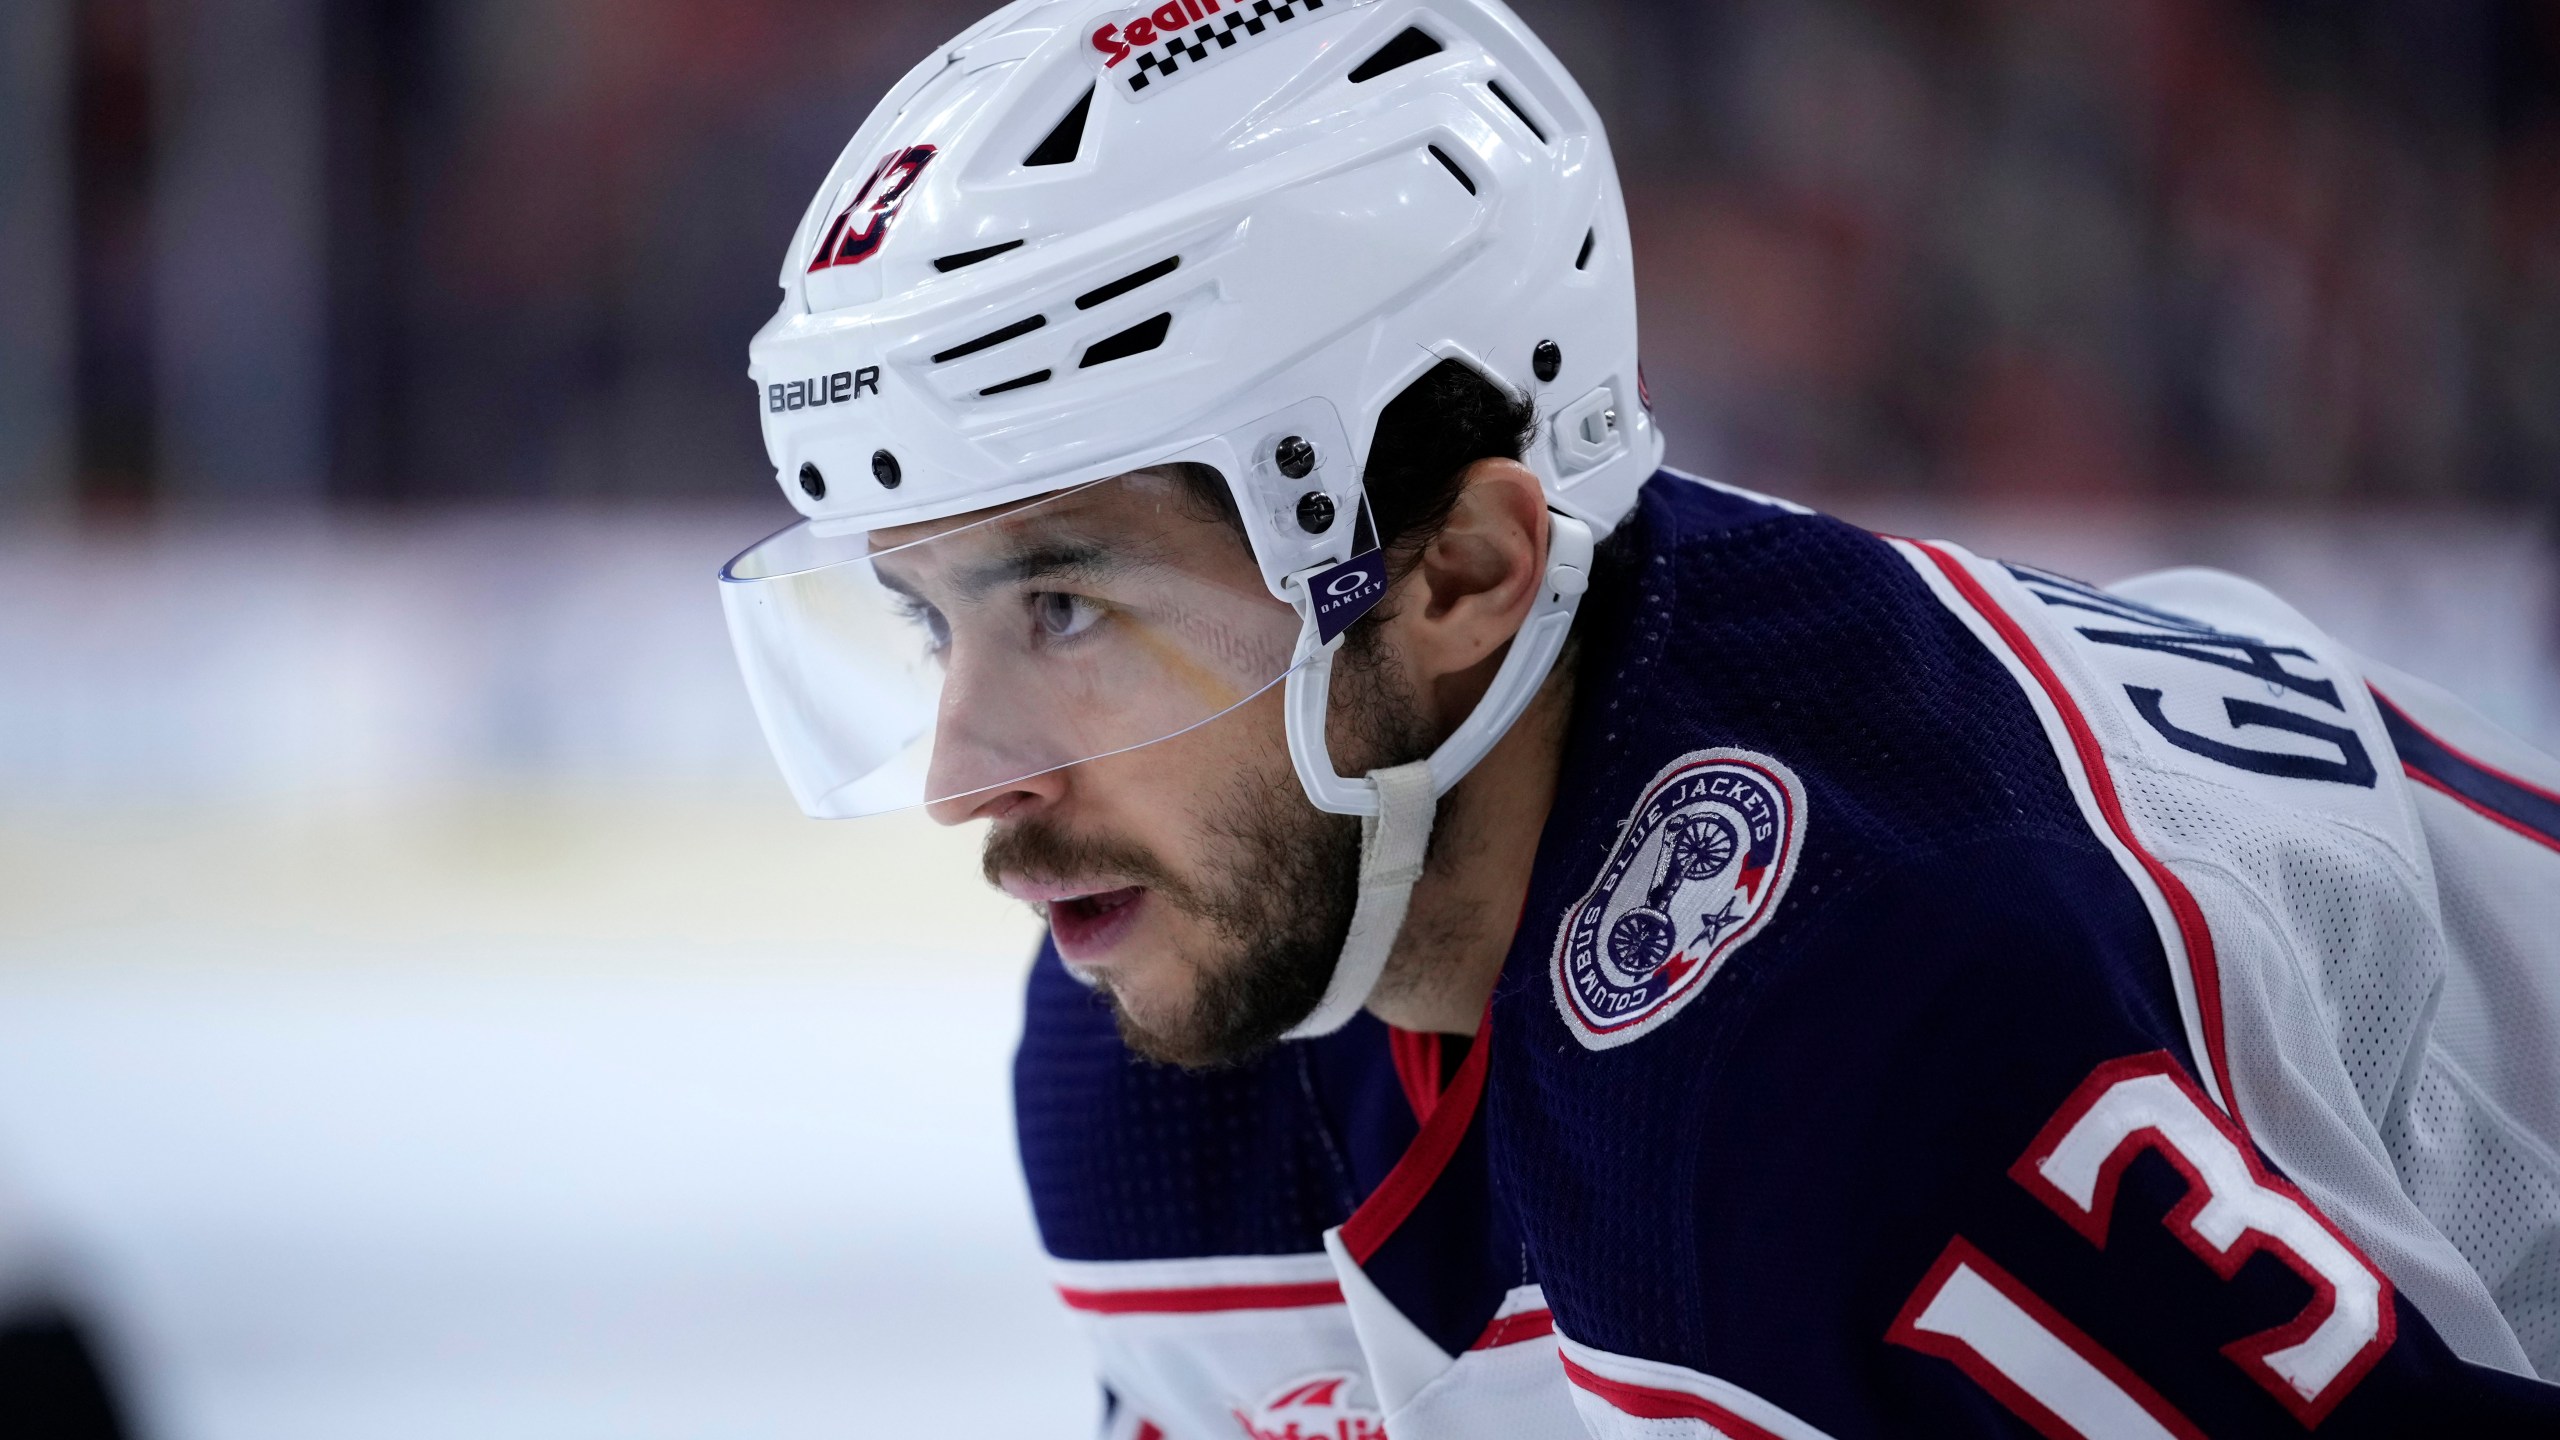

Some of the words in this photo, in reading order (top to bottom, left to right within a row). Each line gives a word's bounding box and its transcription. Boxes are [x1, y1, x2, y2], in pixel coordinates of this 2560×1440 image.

[807, 143, 940, 275] 13
[1320, 580, 1383, 615] OAKLEY
[1602, 803, 1664, 893] BLUE
[1671, 777, 1773, 842] JACKETS
[1576, 904, 1648, 1013] COLUMBUS
[1883, 1048, 2398, 1440] 13
